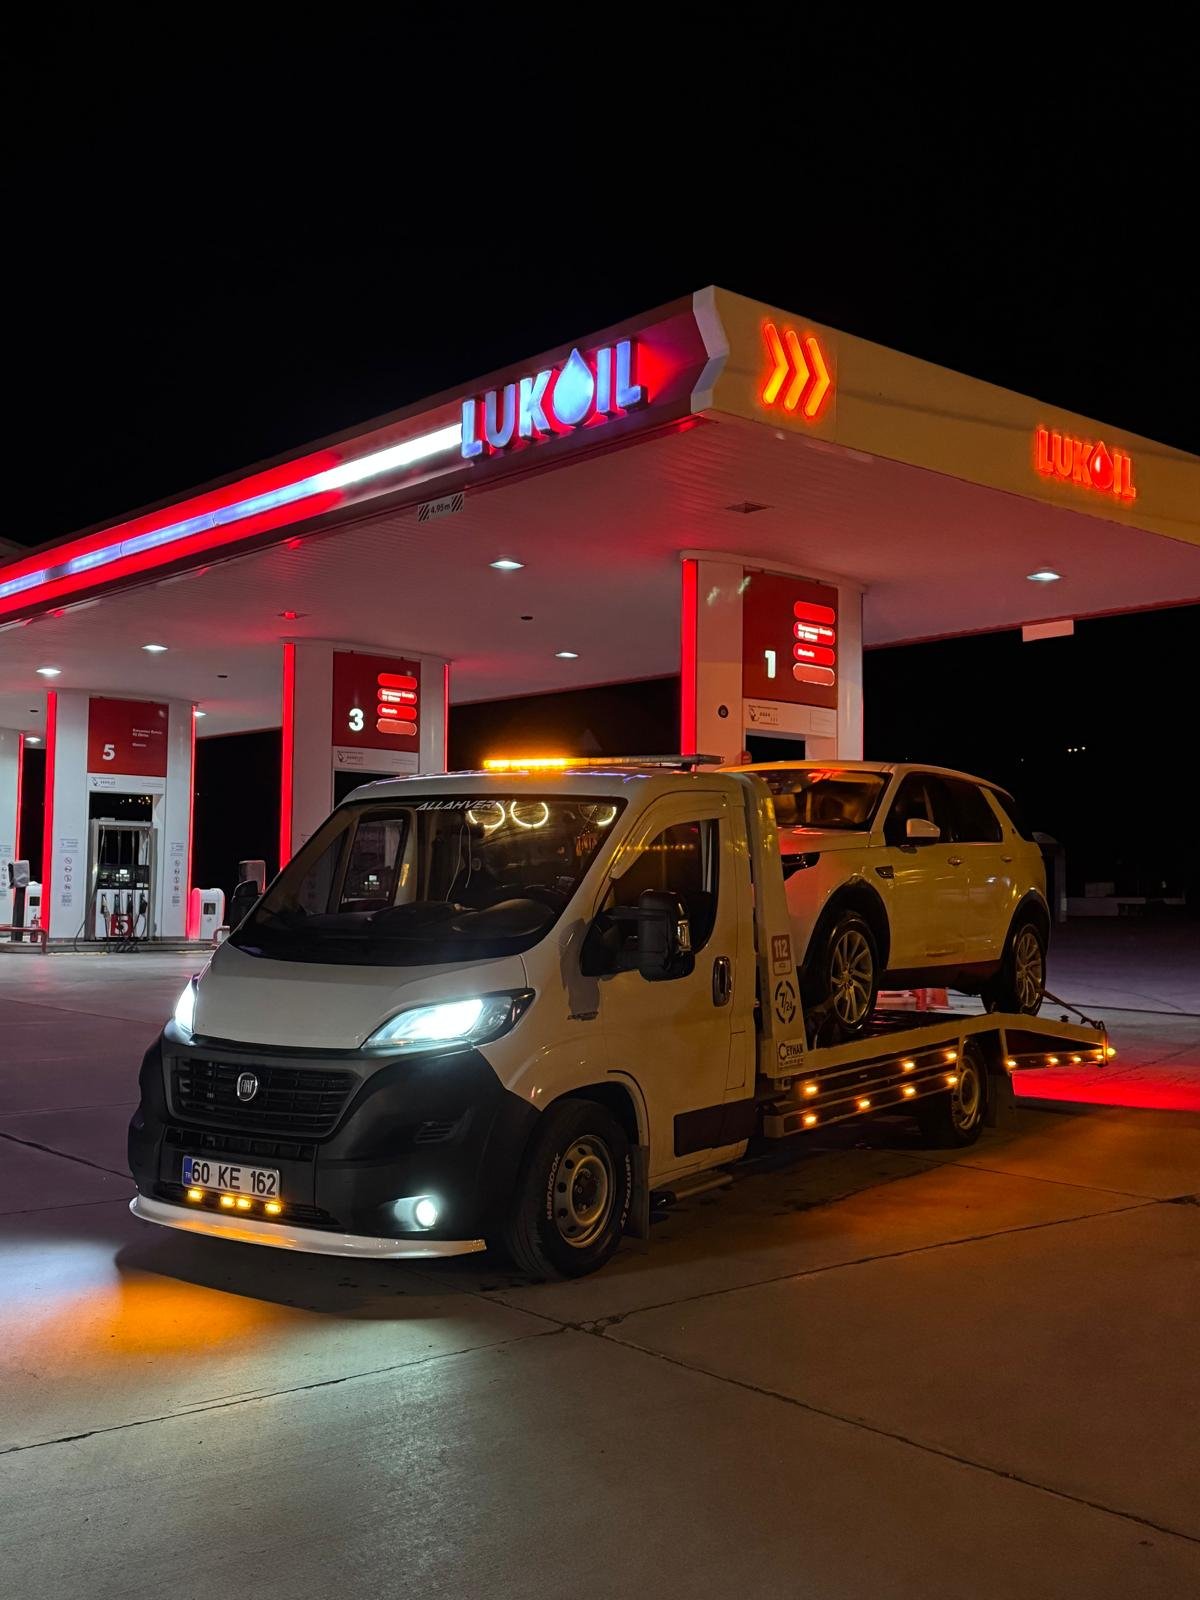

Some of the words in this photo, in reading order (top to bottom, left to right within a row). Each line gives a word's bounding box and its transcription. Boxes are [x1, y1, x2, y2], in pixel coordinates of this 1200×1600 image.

[461, 340, 642, 459] LUKOIL
[1036, 428, 1138, 499] LUKOIL
[765, 650, 776, 679] 1
[348, 708, 364, 731] 3
[102, 744, 116, 761] 5
[114, 914, 129, 935] 5
[774, 938, 789, 958] 112
[192, 1161, 210, 1184] 60
[218, 1165, 241, 1190] KE
[250, 1170, 276, 1195] 162
